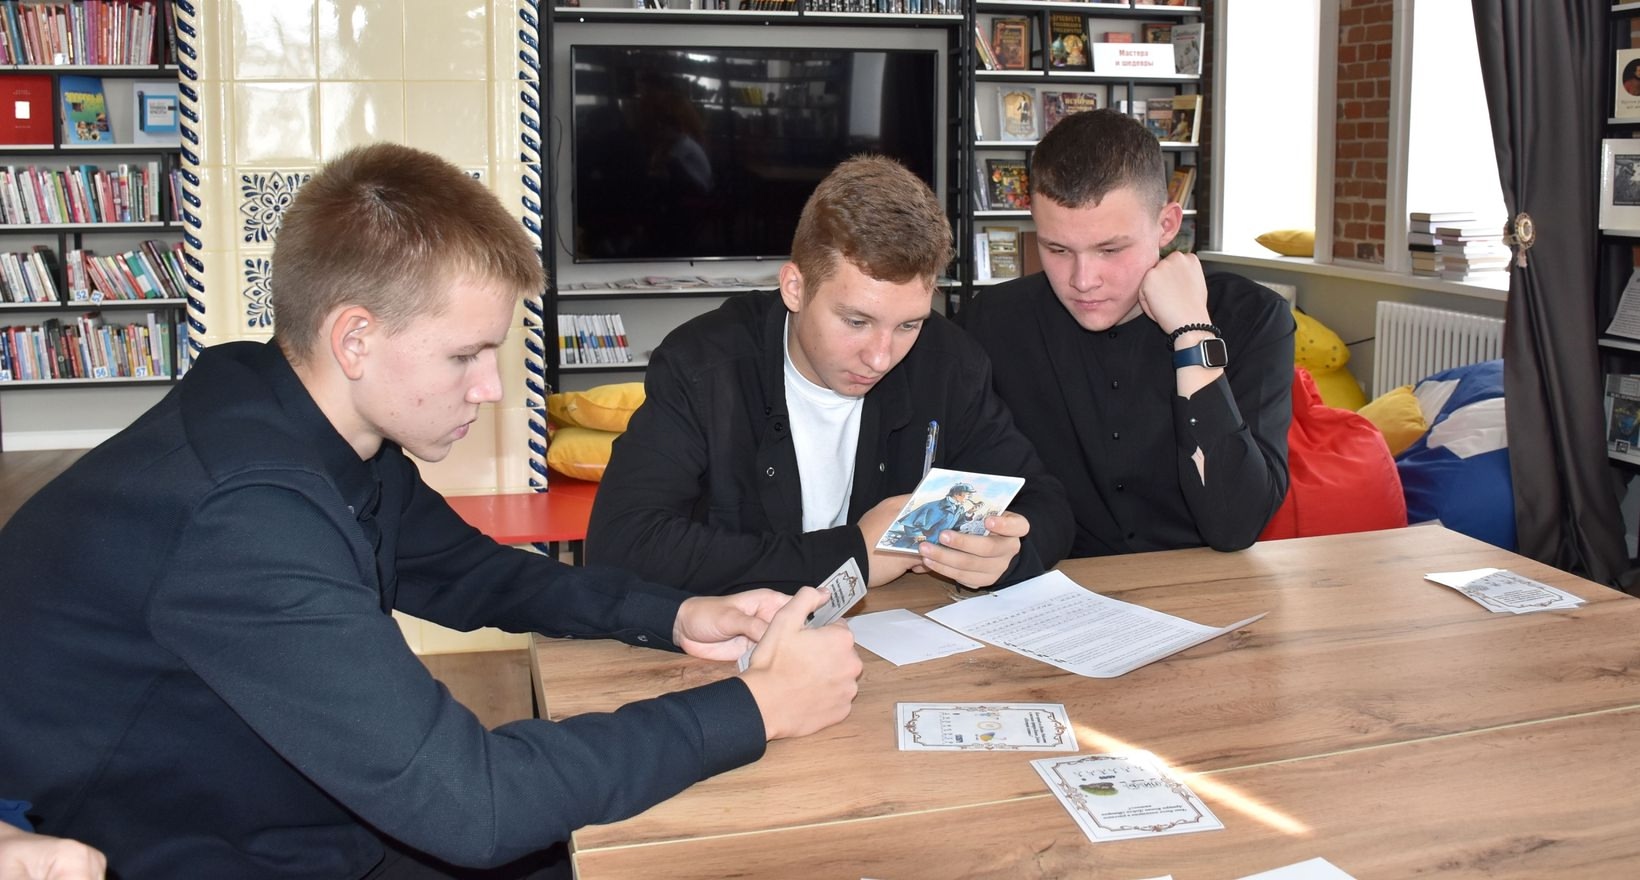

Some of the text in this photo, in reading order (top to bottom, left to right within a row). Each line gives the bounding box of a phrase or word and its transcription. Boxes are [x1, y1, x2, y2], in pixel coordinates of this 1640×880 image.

[1119, 49, 1149, 57] Мастера
[76, 290, 87, 300] 52
[136, 367, 146, 377] 57
